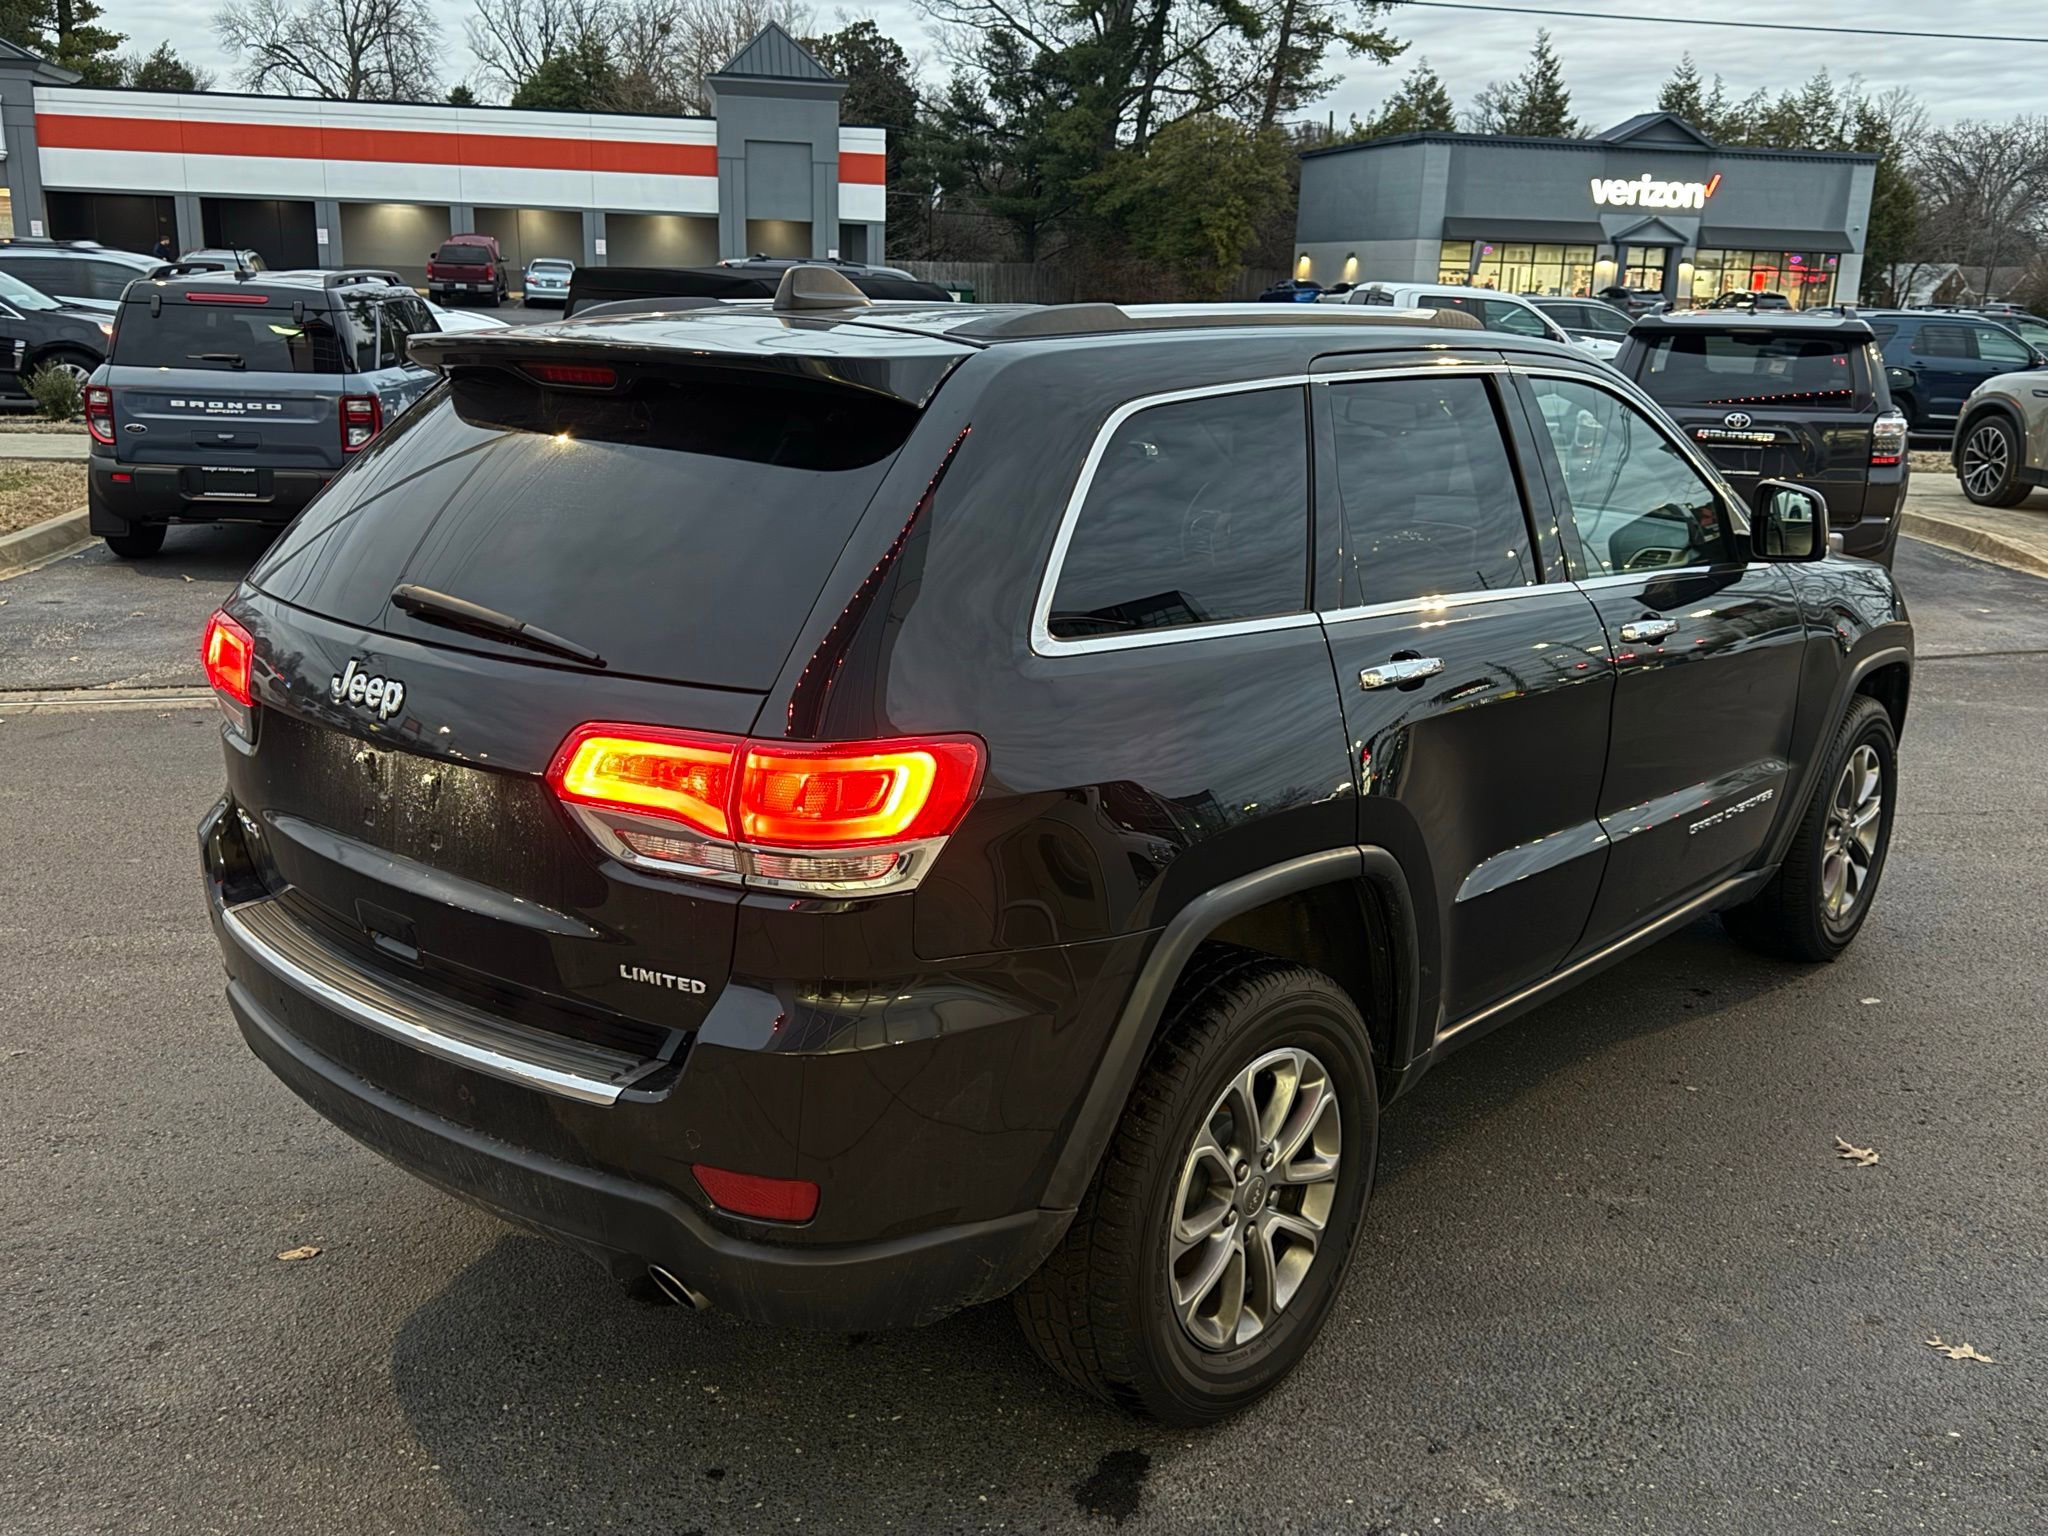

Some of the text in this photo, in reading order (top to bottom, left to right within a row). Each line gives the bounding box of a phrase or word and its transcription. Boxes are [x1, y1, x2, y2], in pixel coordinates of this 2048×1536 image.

[1591, 173, 1706, 209] verizon
[170, 399, 282, 411] BRONCO
[330, 659, 404, 720] Jeep
[619, 963, 707, 995] LIMITED
